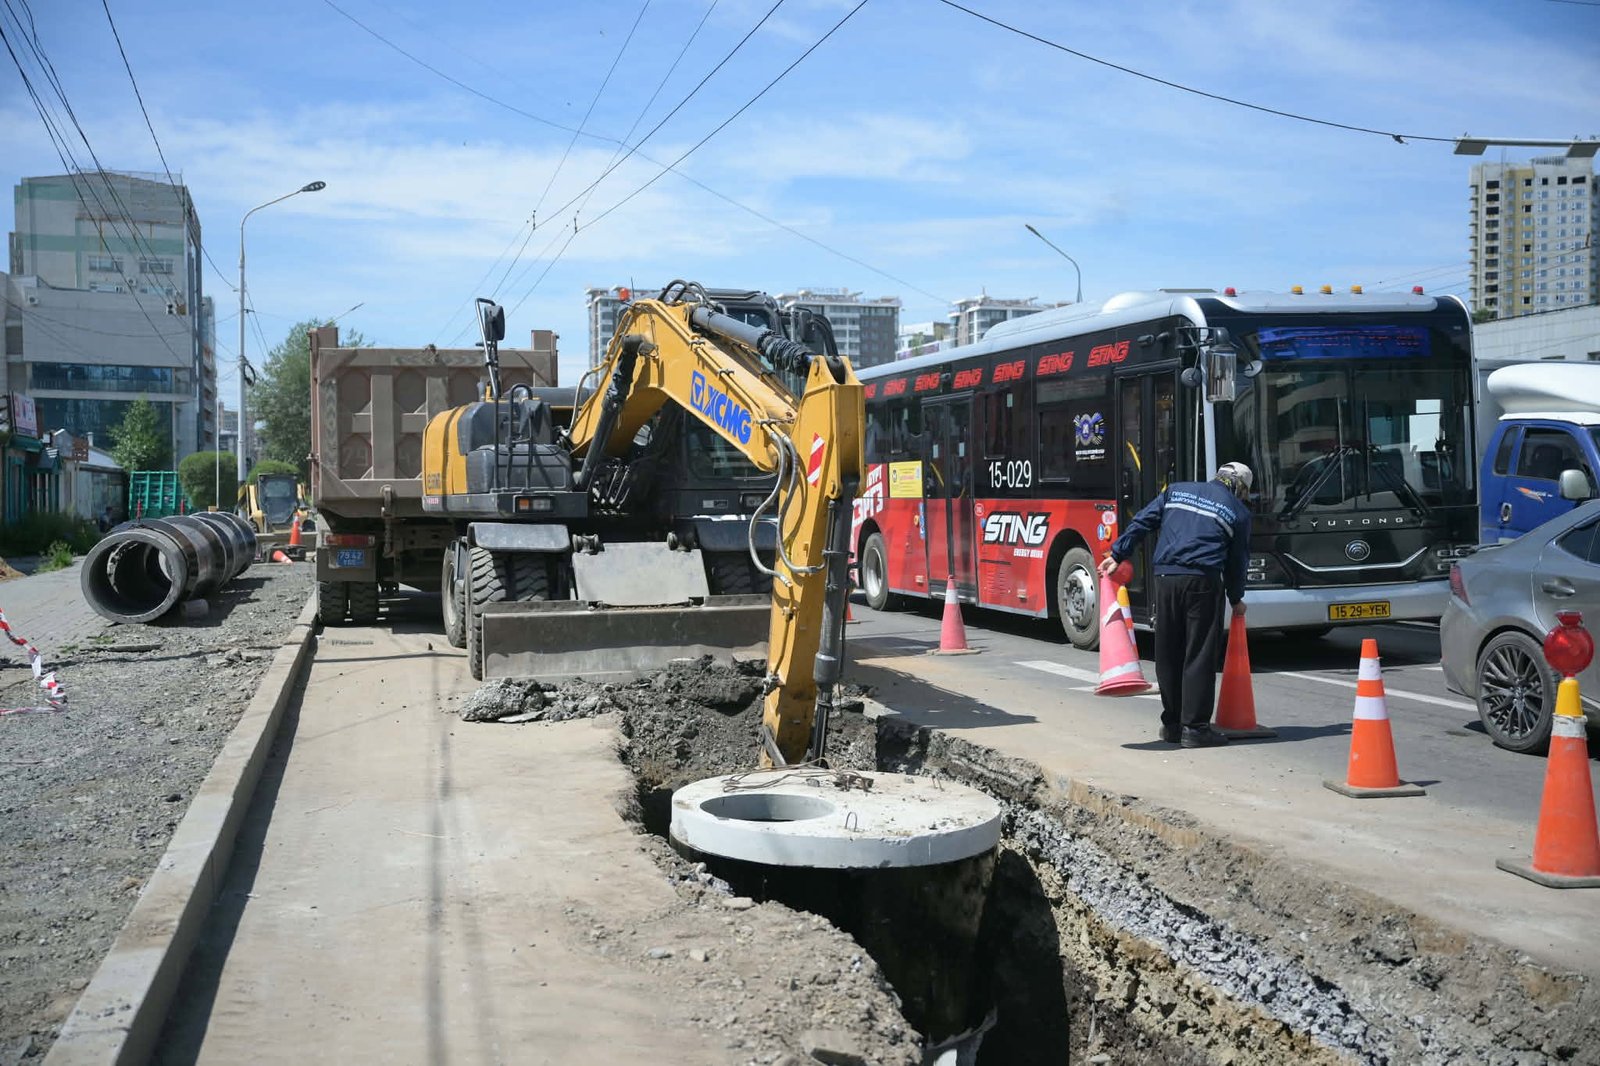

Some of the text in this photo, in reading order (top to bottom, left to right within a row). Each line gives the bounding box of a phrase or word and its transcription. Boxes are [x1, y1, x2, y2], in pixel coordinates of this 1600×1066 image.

[953, 368, 984, 389] STING
[992, 360, 1025, 383] STING
[1036, 351, 1075, 376] STING
[1087, 341, 1130, 367] STING
[704, 384, 752, 445] XCMG
[989, 460, 1032, 488] 15-029
[984, 513, 1049, 545] STING
[1310, 517, 1404, 527] YUTONG
